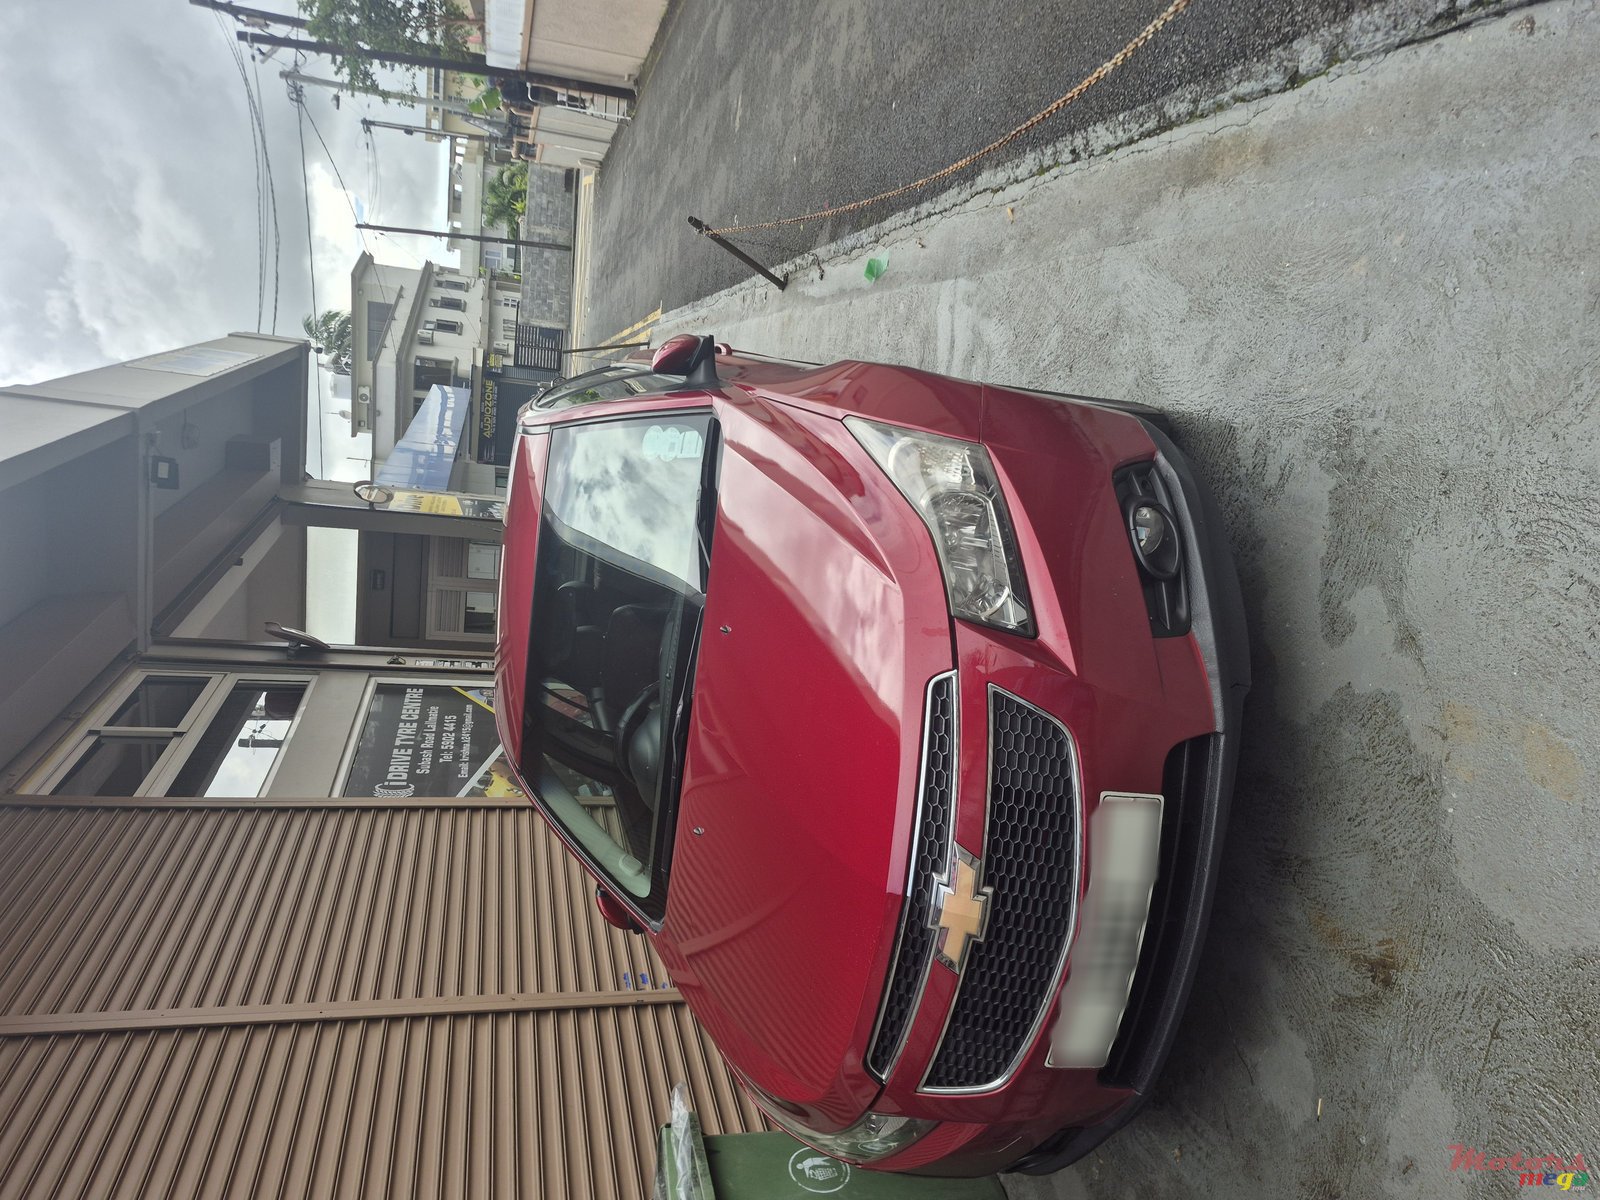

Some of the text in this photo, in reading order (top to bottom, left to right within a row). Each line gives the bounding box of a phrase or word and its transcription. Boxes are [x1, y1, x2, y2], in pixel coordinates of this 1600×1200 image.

[483, 380, 493, 438] AUDIOZONE
[400, 688, 424, 720] CENTRE
[395, 722, 418, 746] TYRE
[416, 706, 439, 774] Subash Road Lallmatie
[440, 715, 457, 762] Tel: 5902 4415
